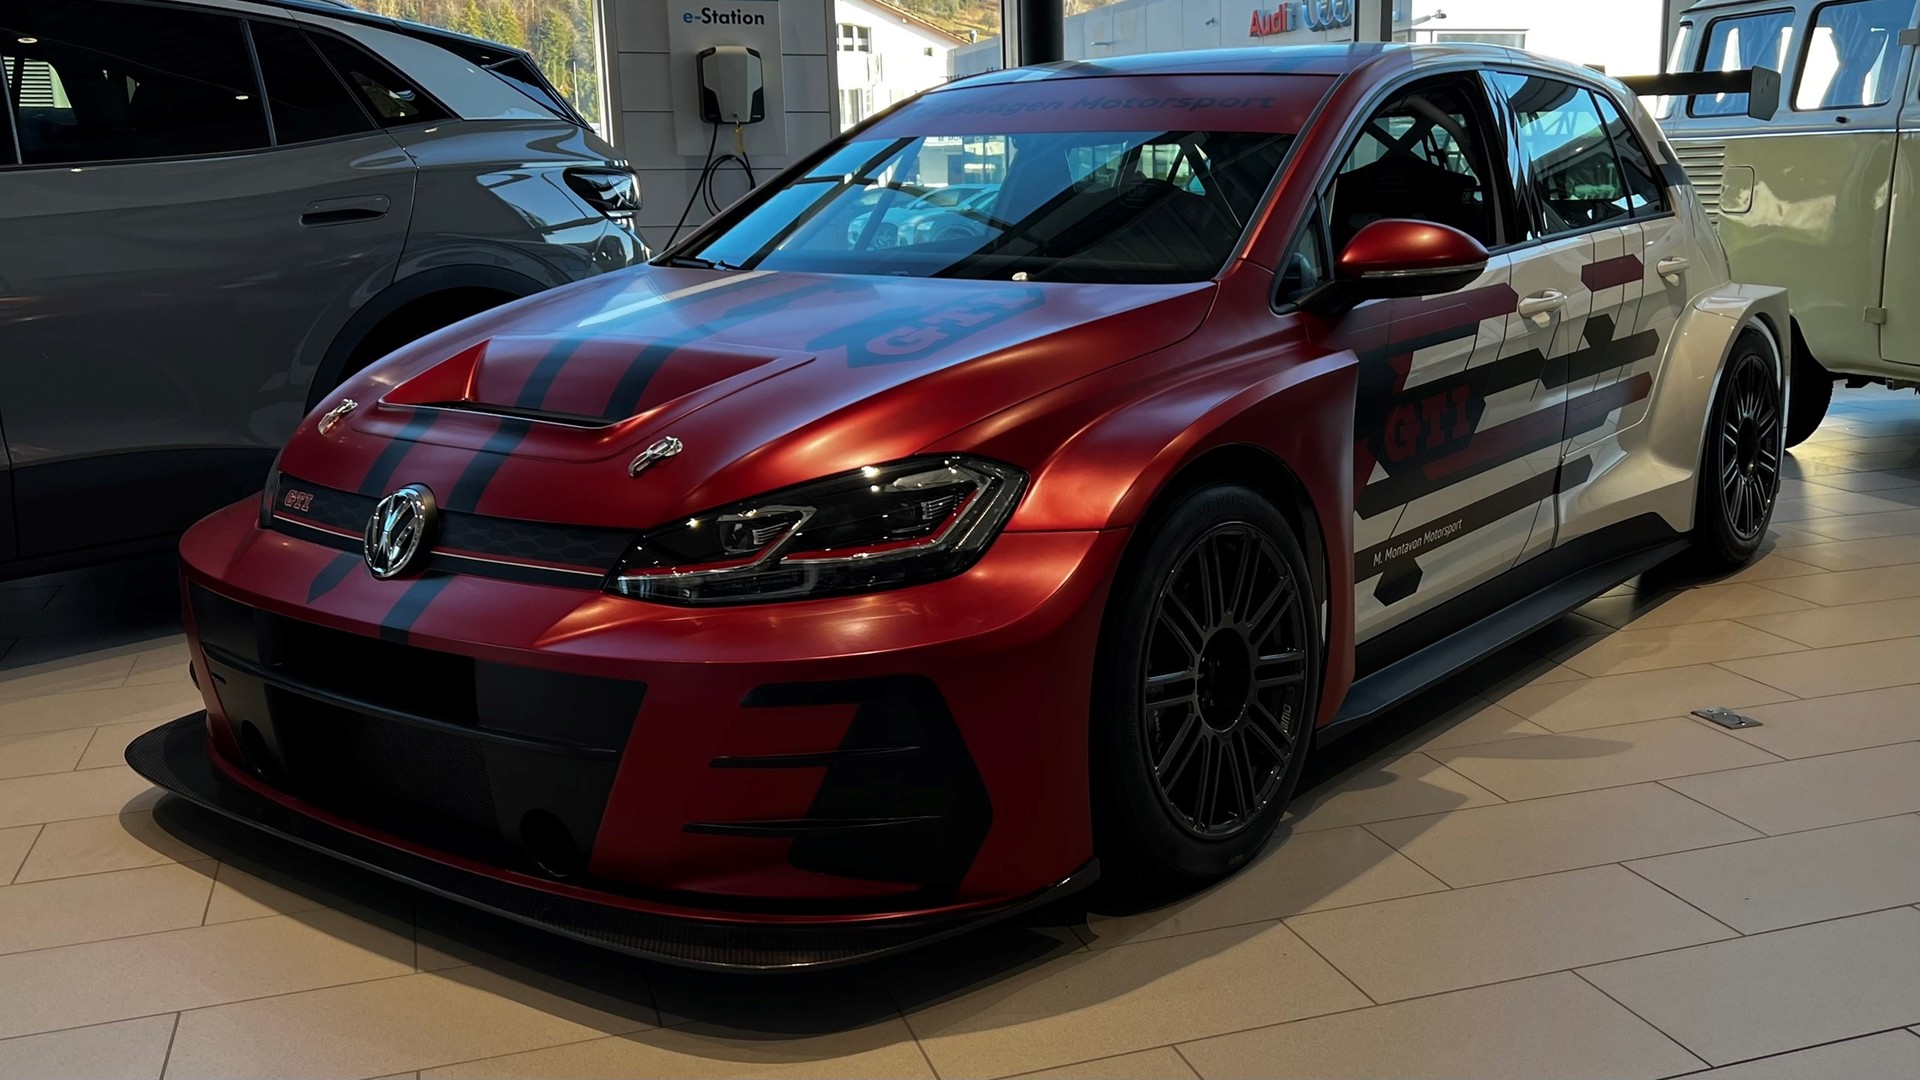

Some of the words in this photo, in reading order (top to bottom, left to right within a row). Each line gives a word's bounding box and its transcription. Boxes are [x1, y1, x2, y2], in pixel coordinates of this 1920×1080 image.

[683, 7, 765, 25] e-Station
[1249, 3, 1287, 37] Audi
[1068, 96, 1277, 112] Motorsport
[866, 293, 1034, 356] GTI
[1384, 384, 1471, 462] GTI
[284, 489, 314, 512] GTI
[1373, 551, 1383, 567] M.
[1384, 537, 1422, 561] Montavon
[1423, 519, 1463, 544] Motorsport
